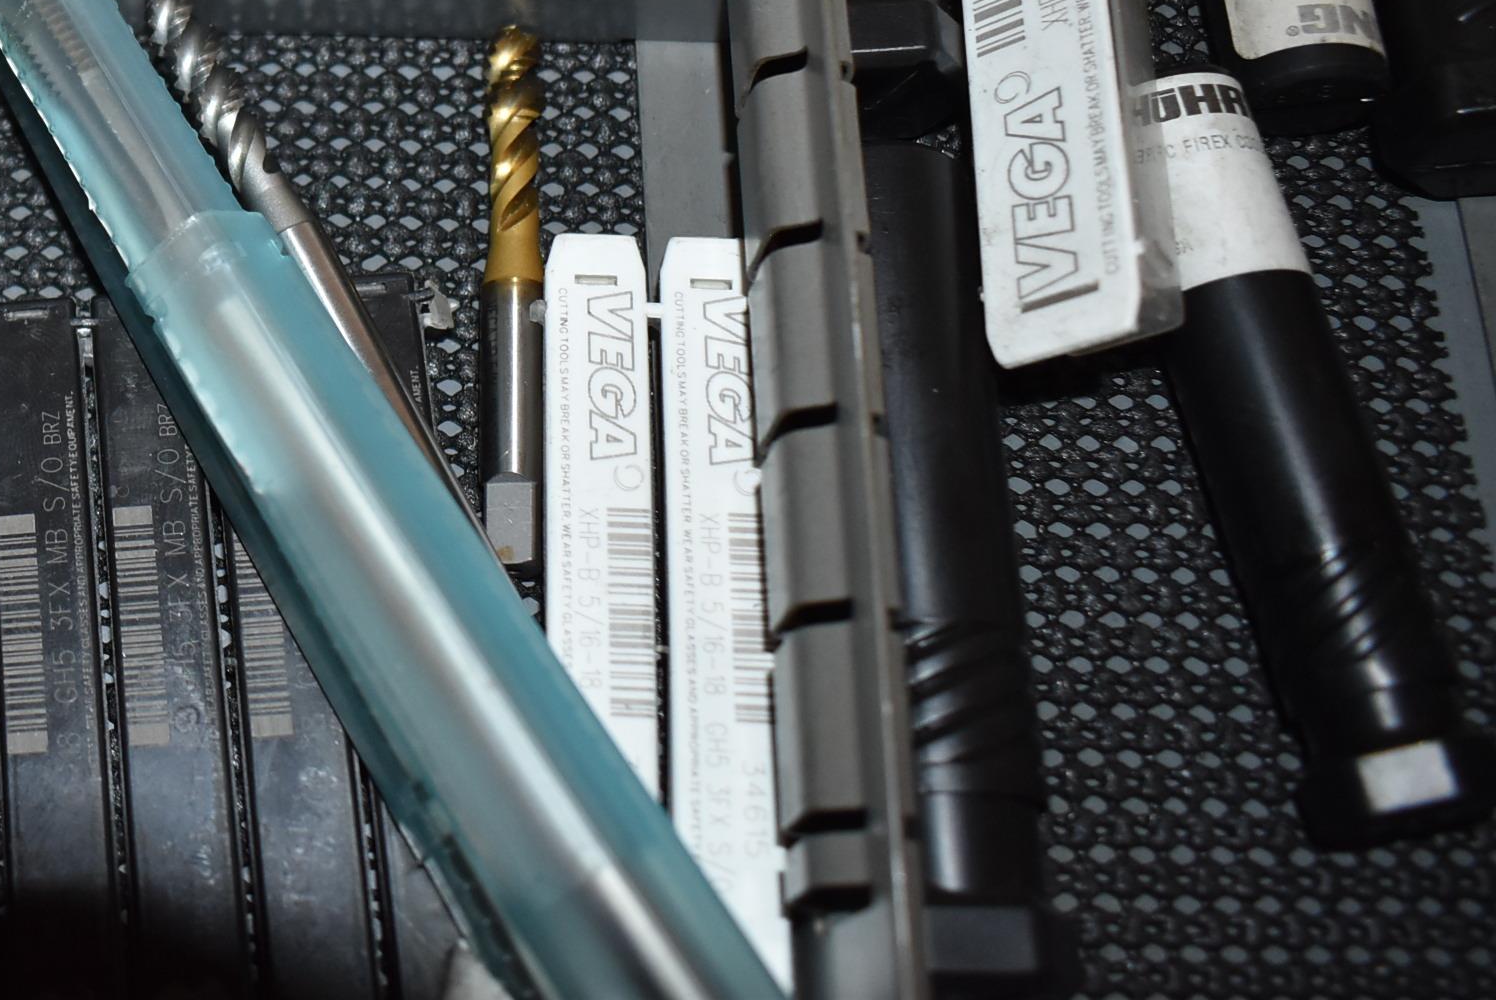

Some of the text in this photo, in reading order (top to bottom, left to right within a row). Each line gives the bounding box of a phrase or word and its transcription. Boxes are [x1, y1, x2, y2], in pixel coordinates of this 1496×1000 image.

[1083, 91, 1104, 135] BREAK
[1089, 133, 1106, 166] MAY
[1004, 86, 1079, 301] VEGA
[1093, 166, 1113, 210] TOOLS
[1098, 213, 1120, 274] CUTTING
[557, 287, 569, 334] CUTTING
[673, 290, 685, 338] CUTTING
[557, 338, 569, 374] TOOLS
[583, 291, 638, 460] VEGA
[675, 342, 686, 378] TOOLS
[559, 376, 569, 400] MAY
[676, 380, 686, 406] MAY
[701, 296, 753, 467] VEGA
[41, 410, 61, 445] BRZ
[559, 404, 570, 441] BREAK
[677, 408, 688, 446] BREAK
[560, 444, 569, 460] OR
[68, 455, 80, 499] SAFETY
[43, 527, 69, 564] MB
[161, 519, 188, 556] MB
[561, 523, 572, 558] WEAR
[573, 507, 601, 581] XHP-B
[681, 529, 693, 564] WEAR
[697, 512, 722, 587] XHP-B
[561, 560, 573, 609] SAFETY
[682, 566, 695, 615] SAFETY
[683, 617, 696, 674] GLASSES
